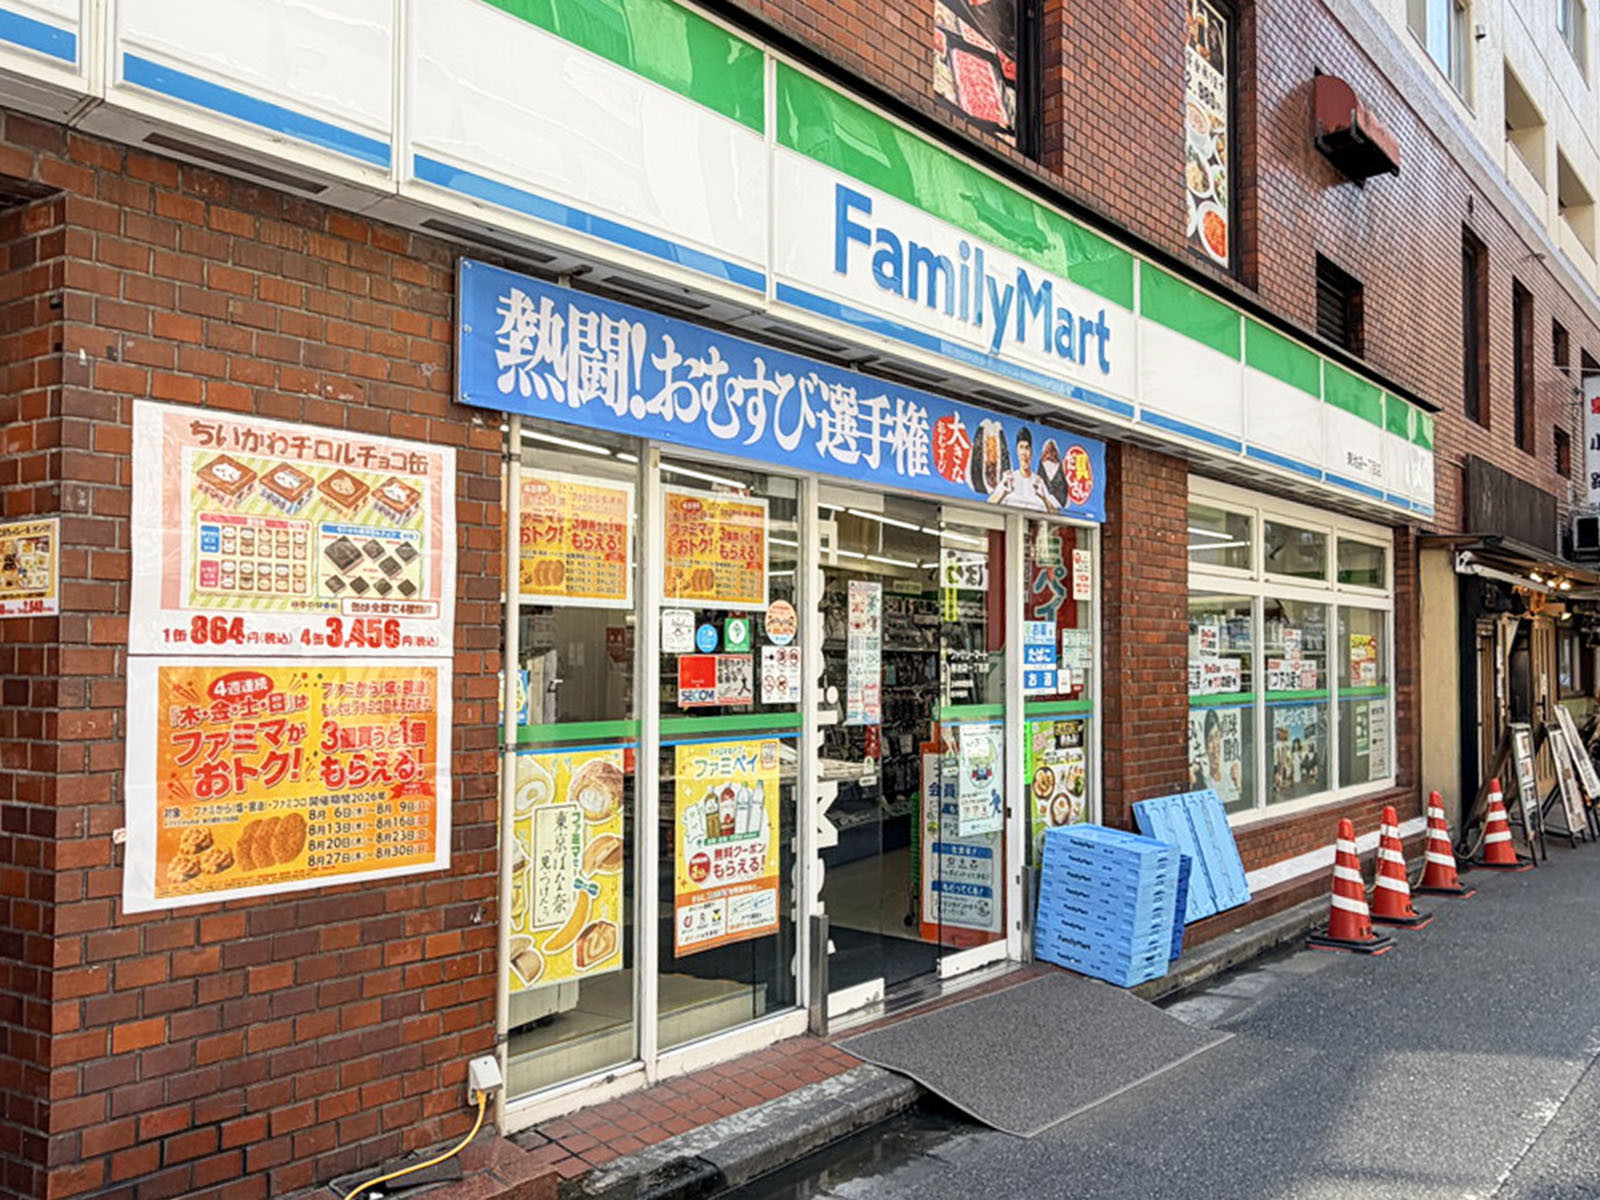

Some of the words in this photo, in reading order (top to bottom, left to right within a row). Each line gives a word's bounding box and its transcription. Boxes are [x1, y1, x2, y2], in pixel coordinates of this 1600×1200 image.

[835, 183, 1110, 375] FamilyMart
[190, 420, 429, 476] ちいかわチロルチョコ缶
[947, 411, 970, 484] 大きな
[173, 719, 306, 763] ファミマが
[694, 754, 758, 777] ファミペイ
[196, 748, 302, 797] おトク!
[321, 749, 425, 788] もらえる!
[553, 810, 568, 914] 東京ばな奈
[713, 855, 765, 878] もらえる!
